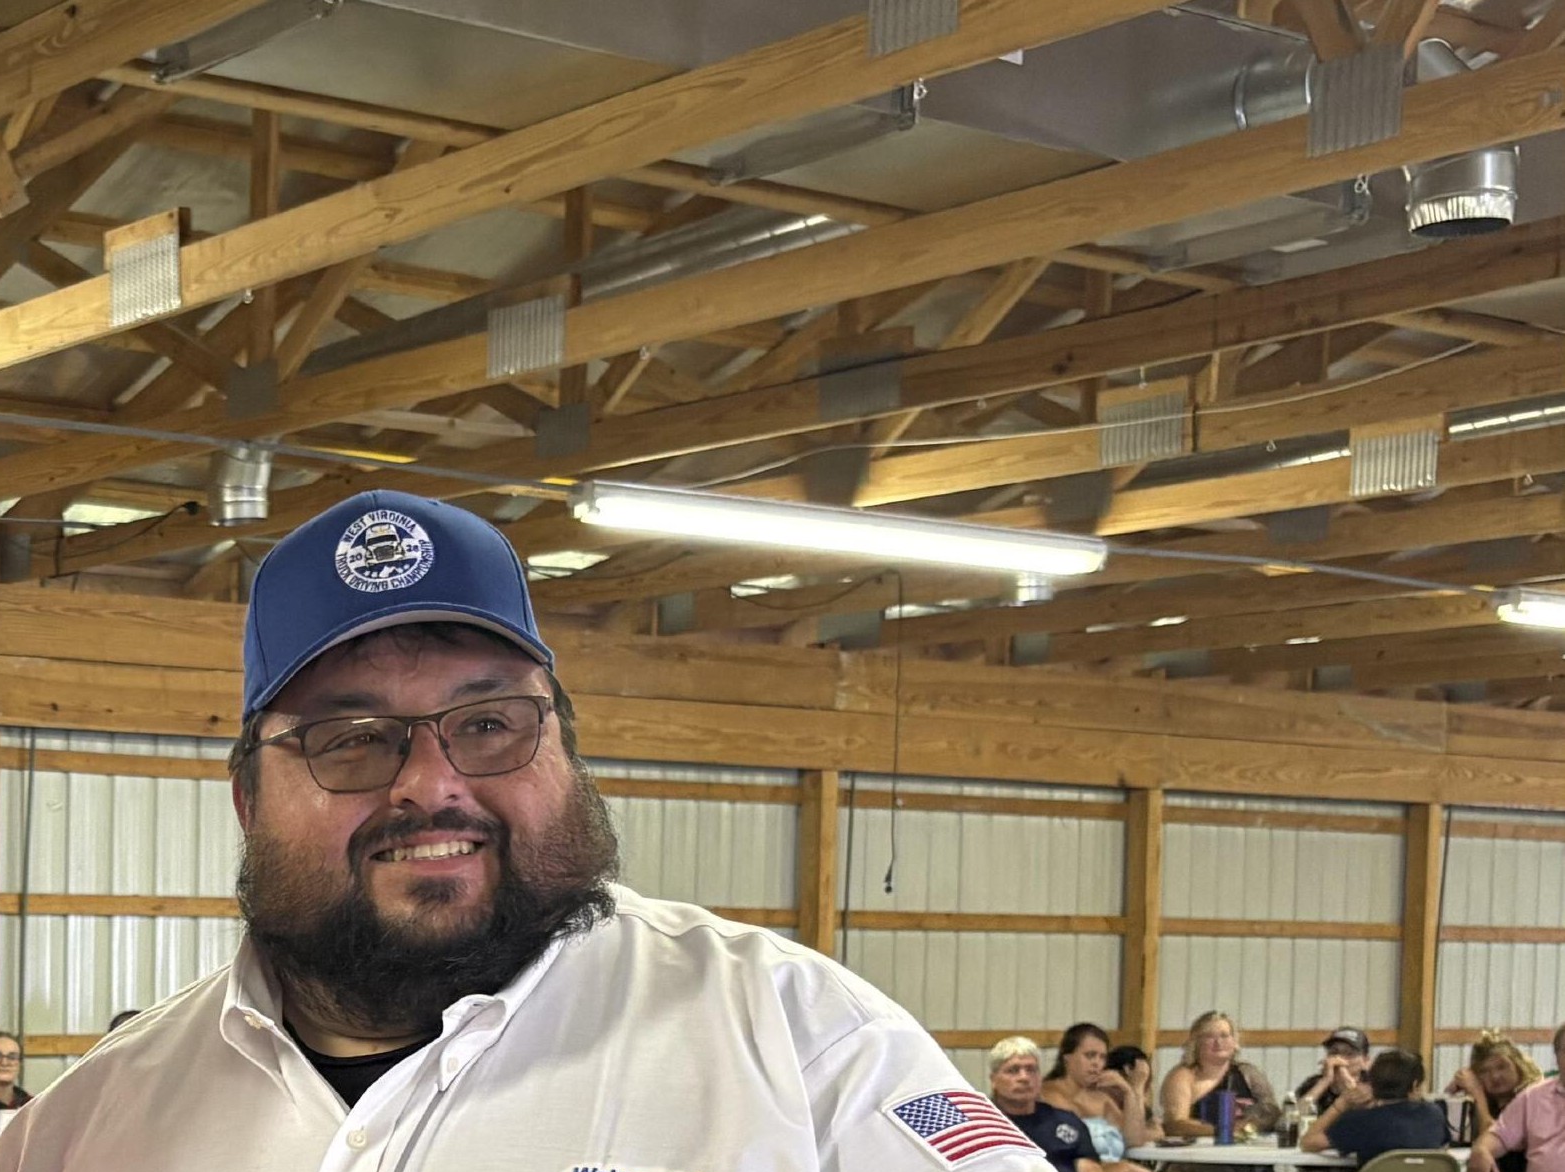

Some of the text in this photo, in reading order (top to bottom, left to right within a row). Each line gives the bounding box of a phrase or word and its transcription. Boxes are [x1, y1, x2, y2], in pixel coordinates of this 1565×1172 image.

[341, 511, 416, 543] WEST VIRGINIA
[349, 552, 363, 563] 20
[348, 578, 389, 590] DRIVING
